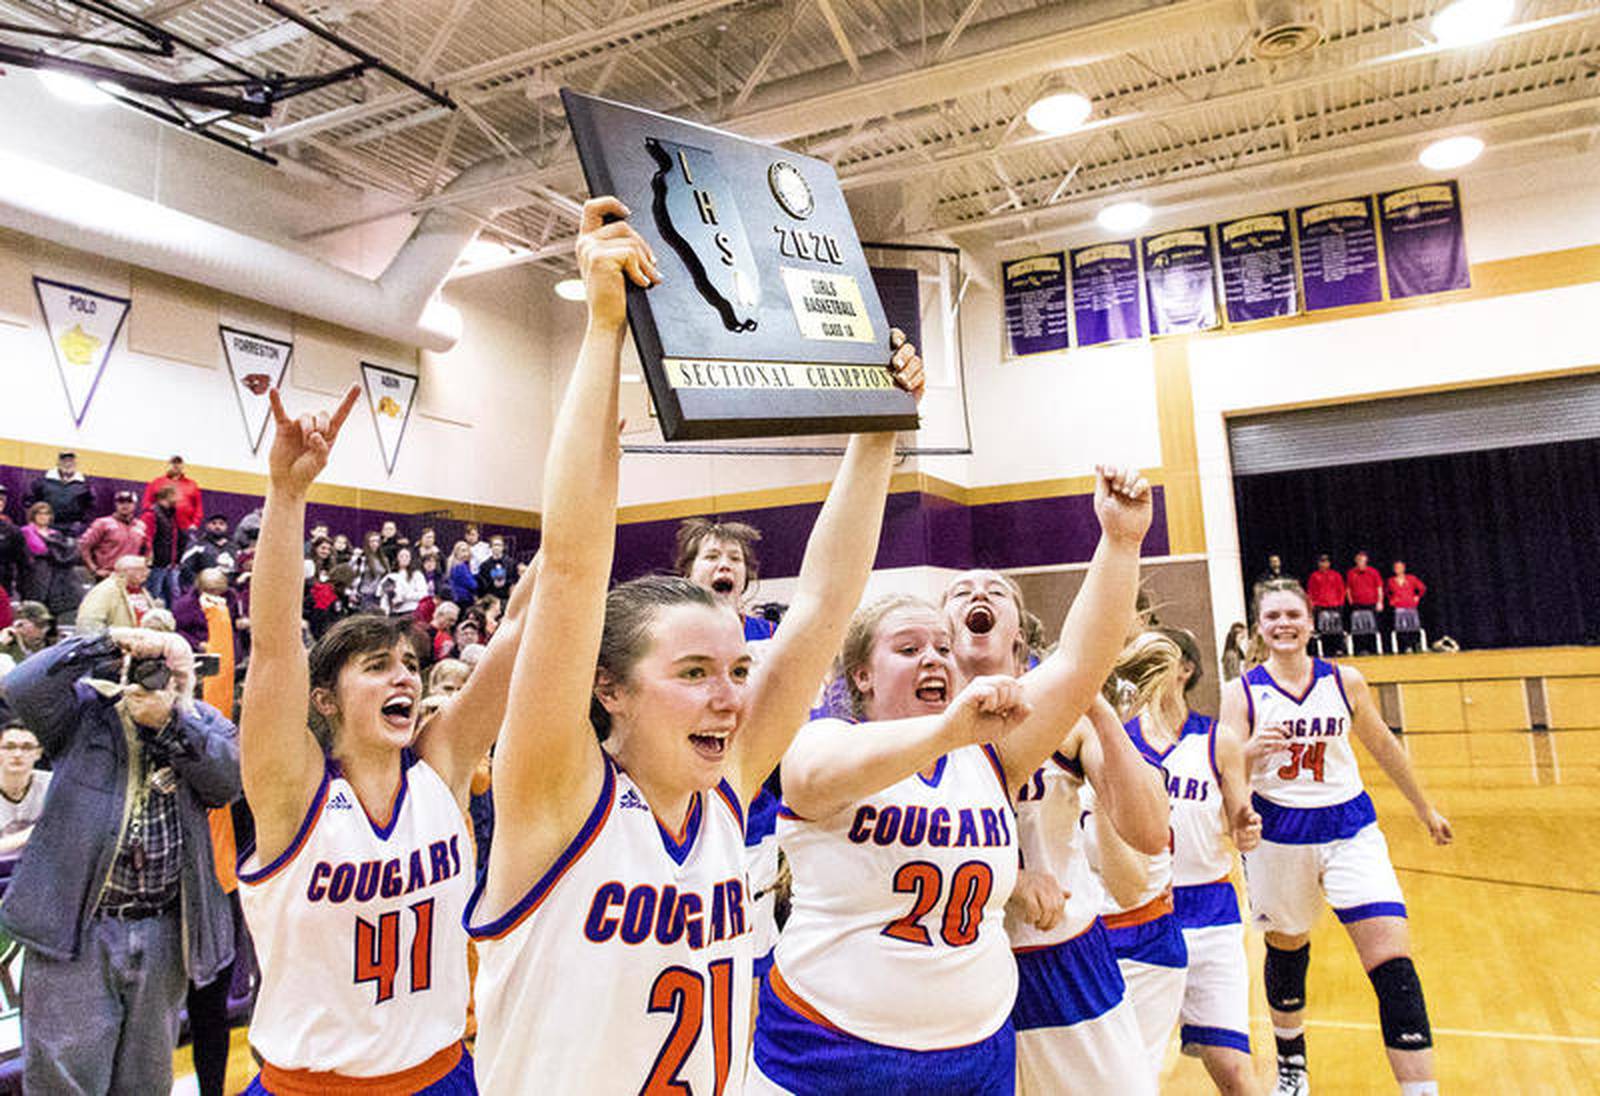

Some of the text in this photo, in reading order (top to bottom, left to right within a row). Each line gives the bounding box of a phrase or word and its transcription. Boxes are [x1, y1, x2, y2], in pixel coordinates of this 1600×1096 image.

[773, 225, 844, 266] 2020
[69, 295, 98, 315] POLO
[803, 296, 858, 318] BASKETBALL
[811, 278, 838, 297] GIRLS
[233, 336, 281, 361] FORRESTON
[680, 363, 795, 389] SECTIONAL
[307, 833, 462, 904] COUGARS
[584, 878, 752, 950] COUGAR
[879, 859, 994, 948] 20
[353, 896, 436, 1006] 41
[637, 956, 735, 1096] 21
